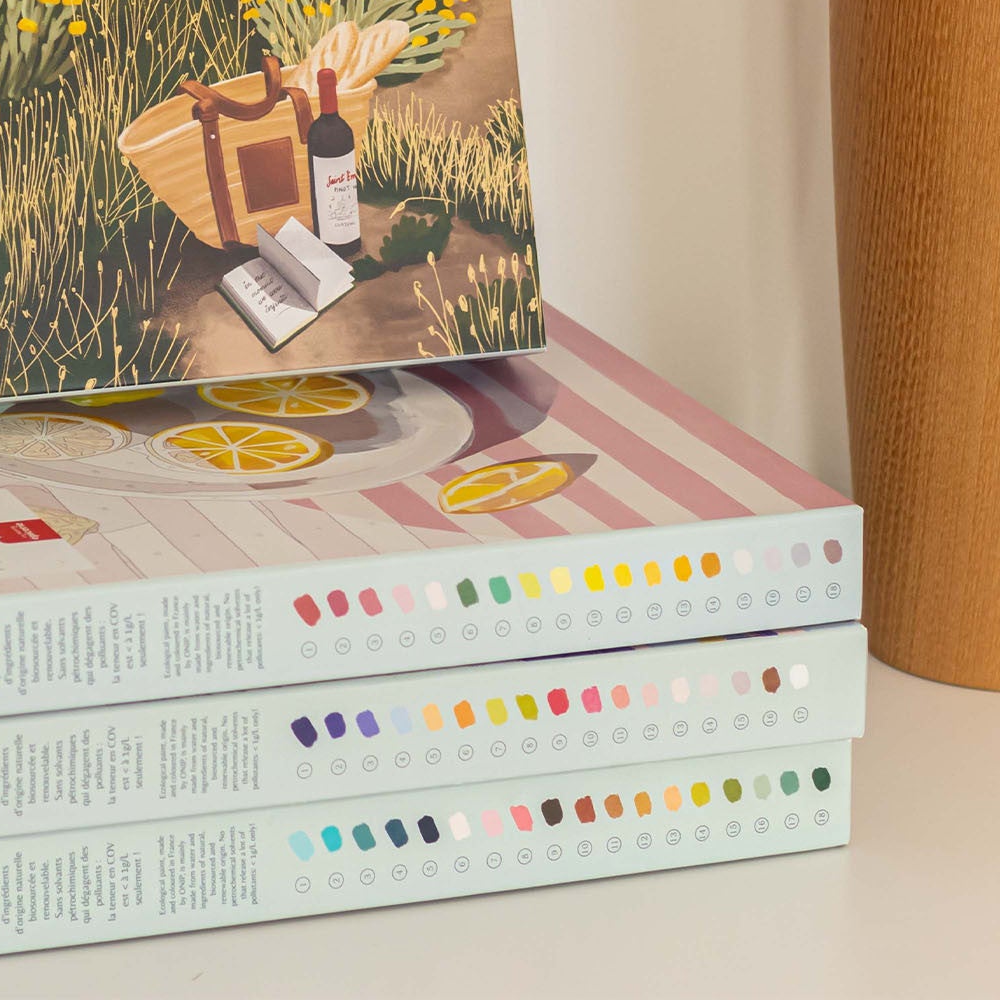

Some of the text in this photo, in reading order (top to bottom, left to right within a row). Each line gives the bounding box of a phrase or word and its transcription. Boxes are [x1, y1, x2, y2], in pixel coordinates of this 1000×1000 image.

[107, 726, 115, 748] COV
[109, 750, 115, 762] en
[121, 737, 130, 756] 1g/L
[14, 734, 24, 816] d'origine naturelle
[28, 744, 36, 804] biosourcée et
[82, 748, 92, 789] dégagent
[95, 749, 103, 789] polluants
[135, 742, 143, 789] seulement
[55, 780, 63, 801] Sans
[82, 793, 91, 806] qui
[107, 842, 115, 865] COV
[109, 867, 115, 878] en
[120, 854, 130, 872] 1g/L
[14, 851, 25, 934] d'origine naturelle
[28, 862, 37, 921] biosourcée et
[55, 857, 63, 918] Sans solvants
[81, 846, 92, 923] qui dégagent des
[95, 865, 104, 906] polluants
[134, 858, 143, 905] seulement
[108, 913, 116, 921] la
